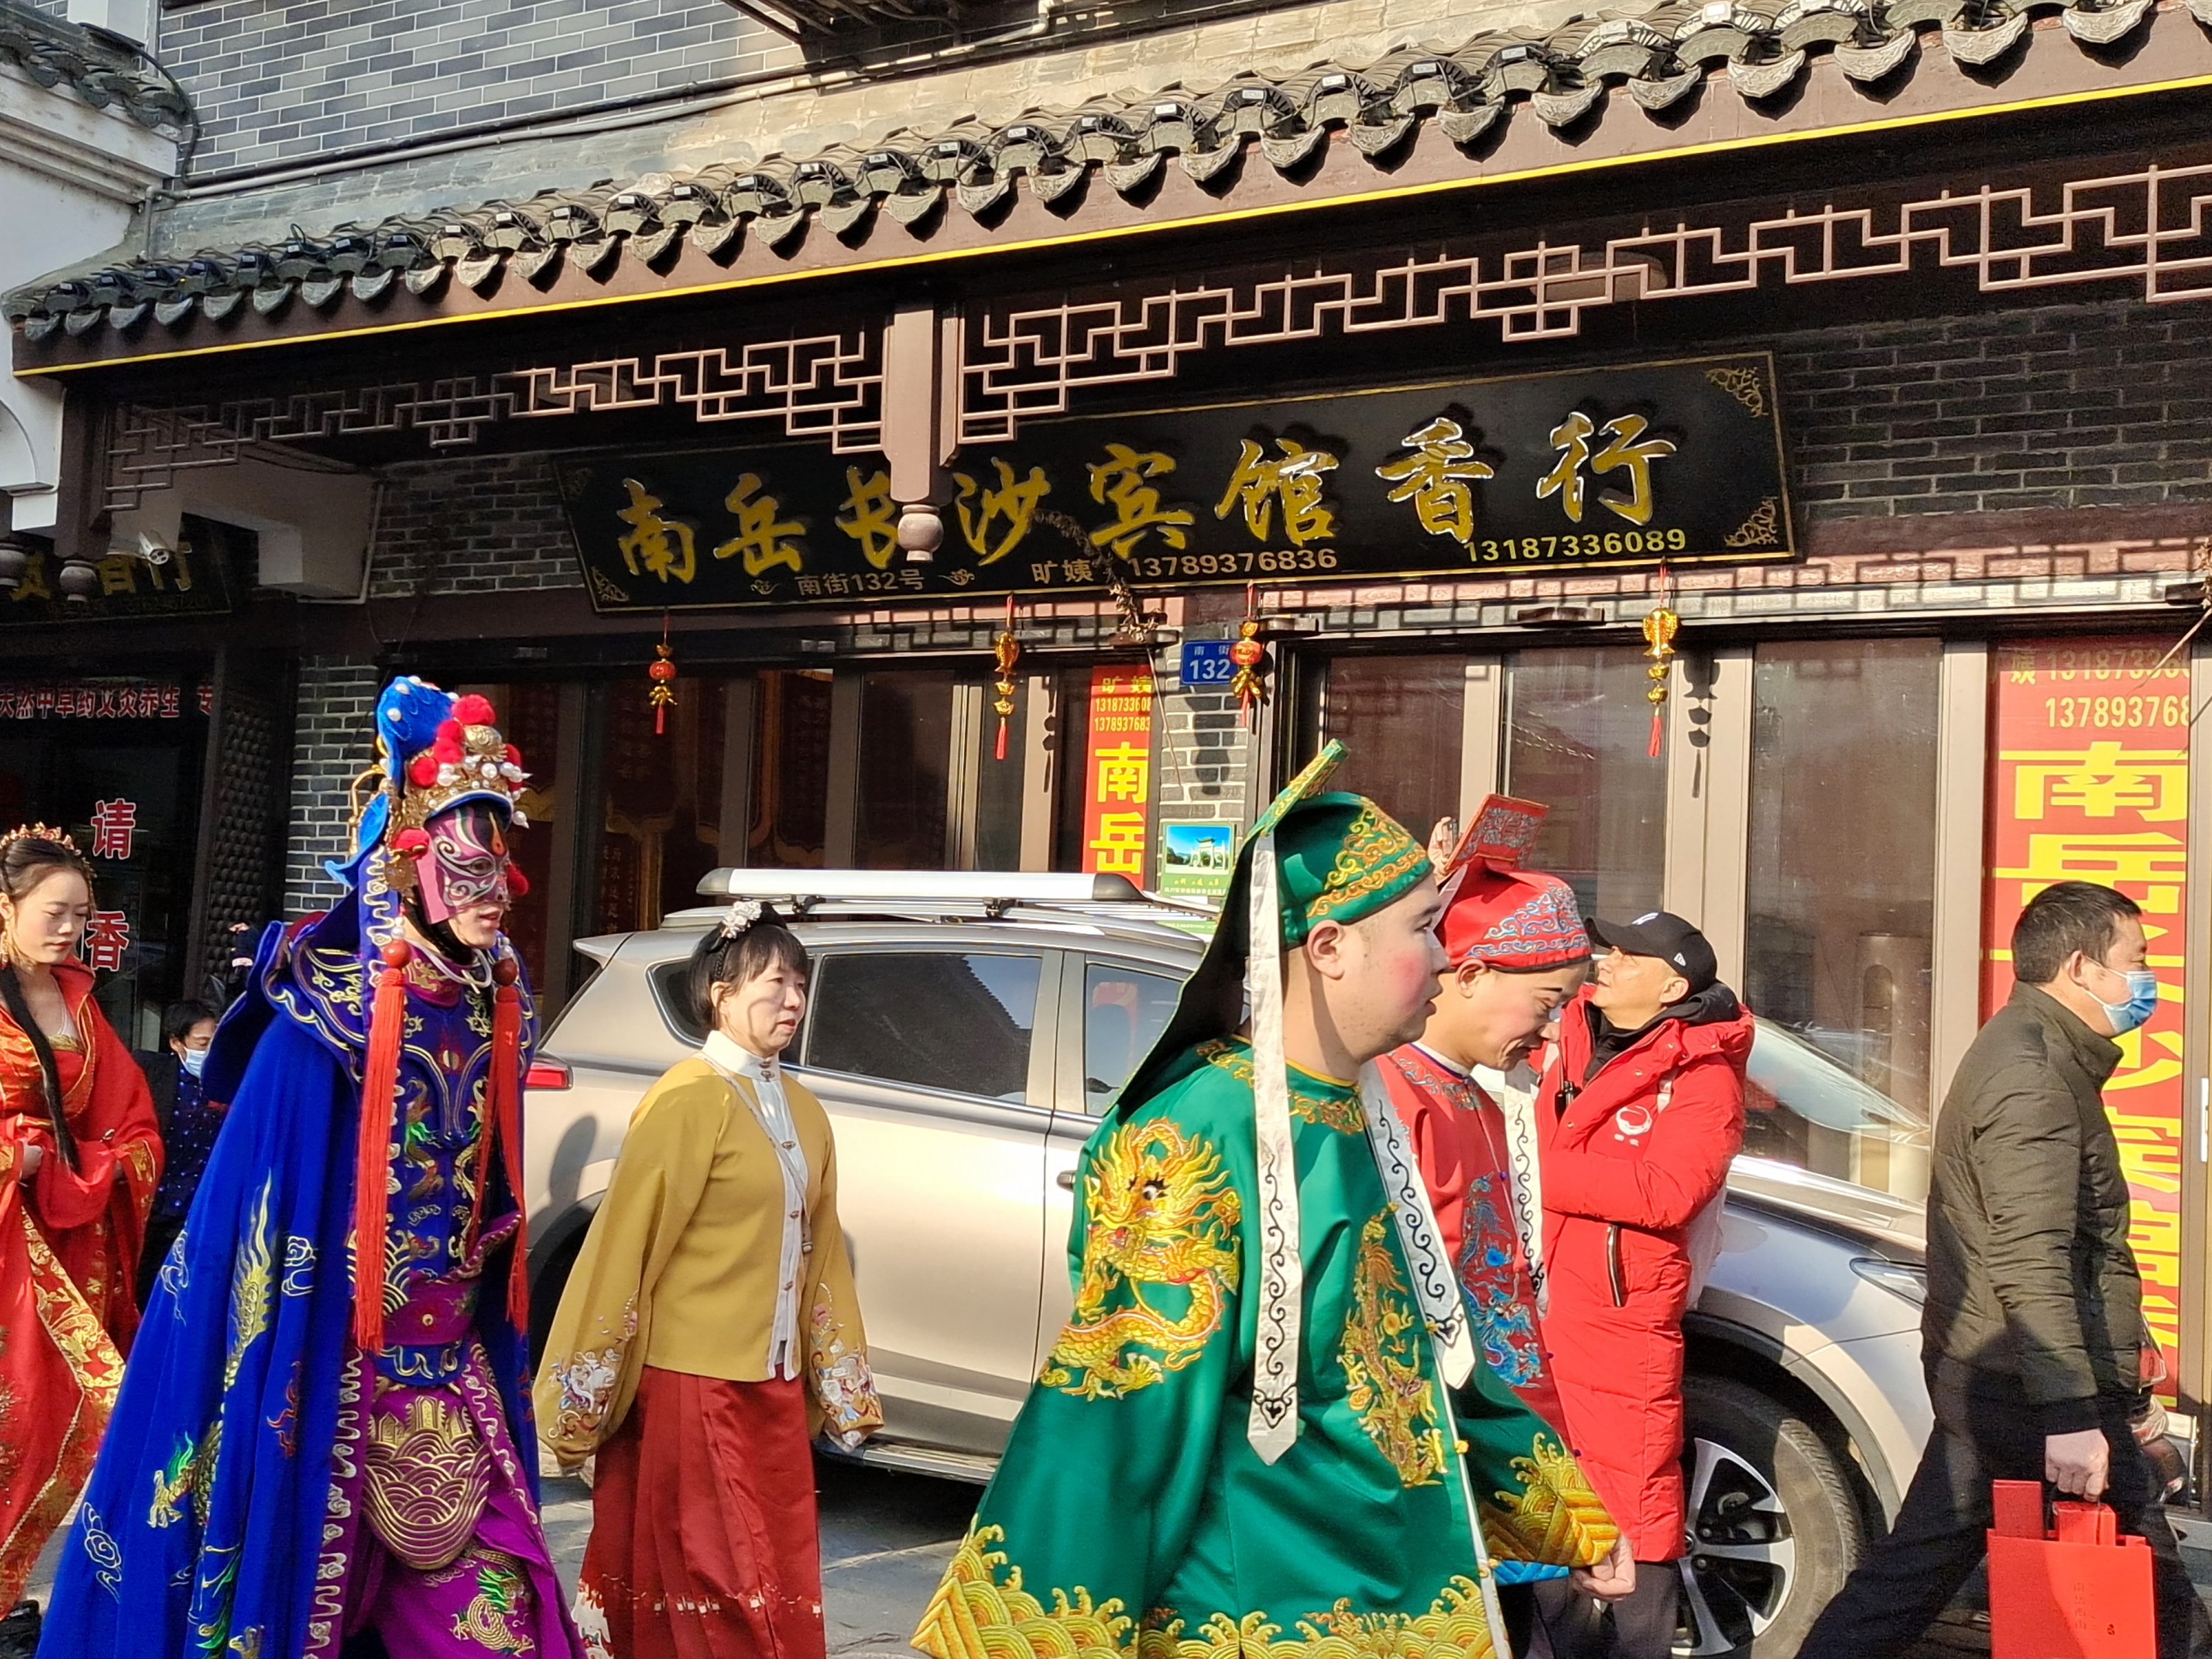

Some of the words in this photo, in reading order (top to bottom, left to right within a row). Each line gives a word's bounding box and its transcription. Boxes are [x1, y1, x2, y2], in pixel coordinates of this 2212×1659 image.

[617, 411, 1677, 584] 南岳长沙宾馆香行
[1464, 528, 1687, 563] 13187336089
[795, 568, 925, 597] 南街132号
[1031, 558, 1095, 585] 旷姨
[1128, 546, 1338, 577] 13789376836
[1193, 644, 1230, 656] 南街
[1189, 658, 1231, 680] 132
[1089, 742, 1149, 875] 南岳
[86, 798, 136, 972] 请香
